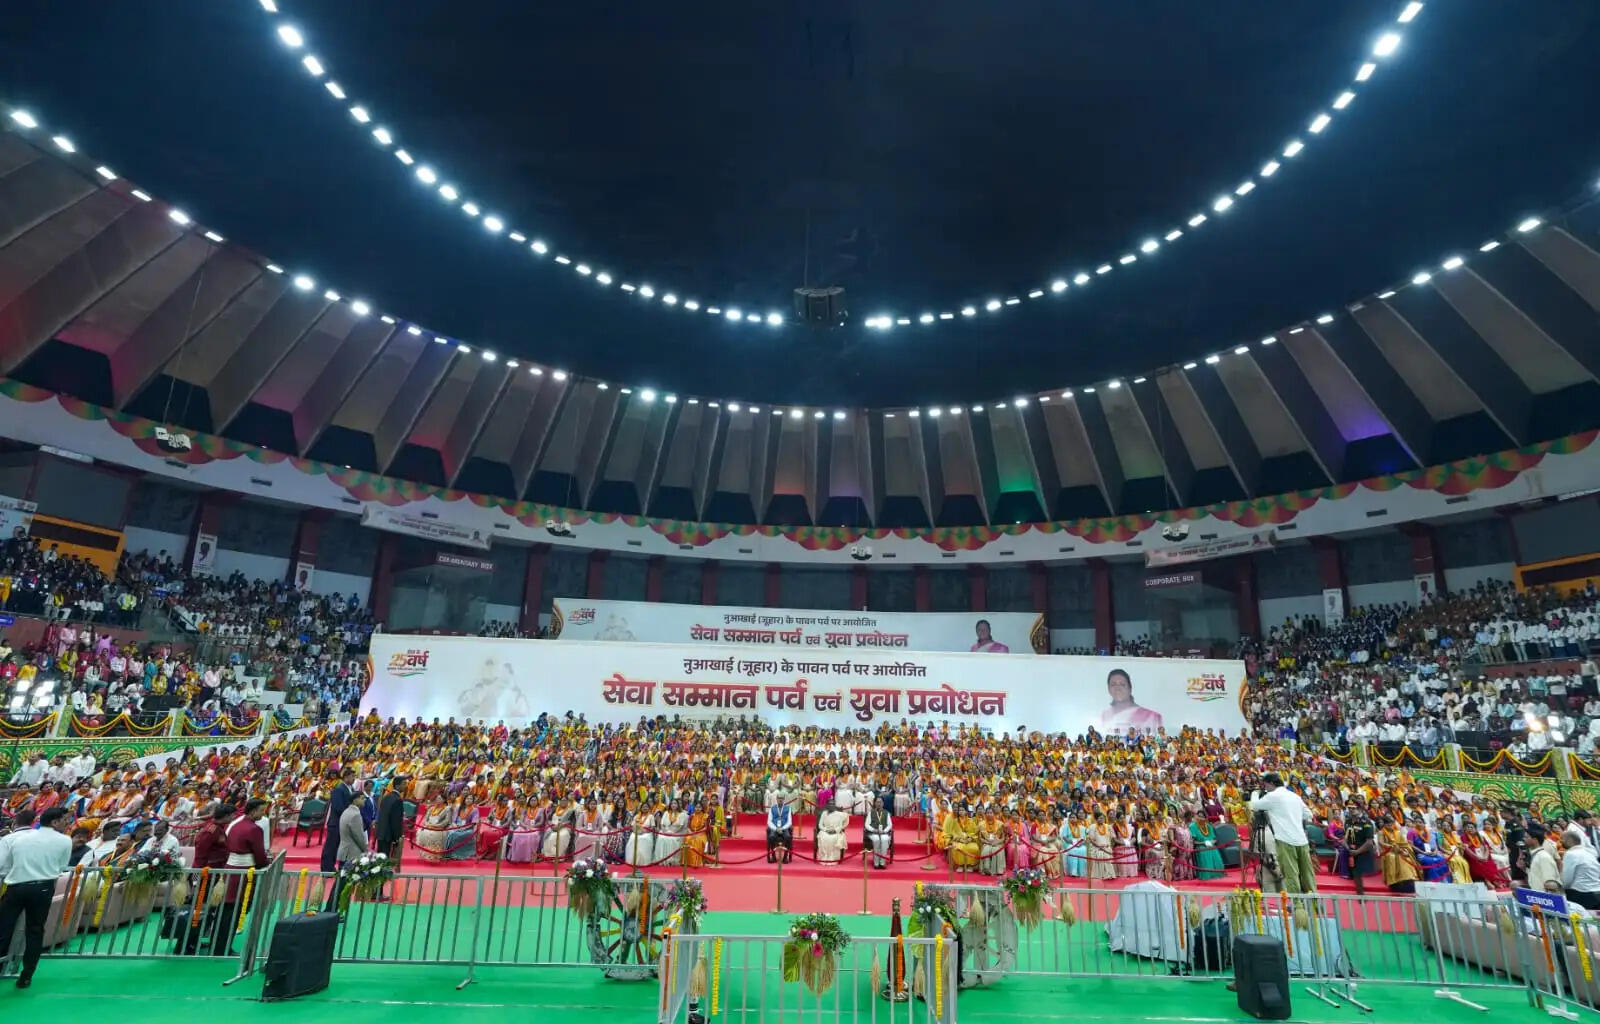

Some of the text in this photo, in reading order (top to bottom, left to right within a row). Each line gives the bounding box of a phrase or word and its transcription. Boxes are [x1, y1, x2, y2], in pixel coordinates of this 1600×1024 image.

[724, 613, 756, 624] नुआखाई
[817, 616, 830, 625] पर्व
[831, 618, 841, 626] पर
[842, 617, 877, 627] आयोजित
[690, 624, 909, 648] सेवा सम्मान पर्व एवं युवा प्रबोधन
[683, 656, 927, 677] नुआखाई (जूहार) के पावन पर्व पर आयोजित
[602, 673, 1007, 722] सेवा सम्मान पर्व एवं युवा प्रबोधन
[1526, 895, 1555, 907] SENIOR
